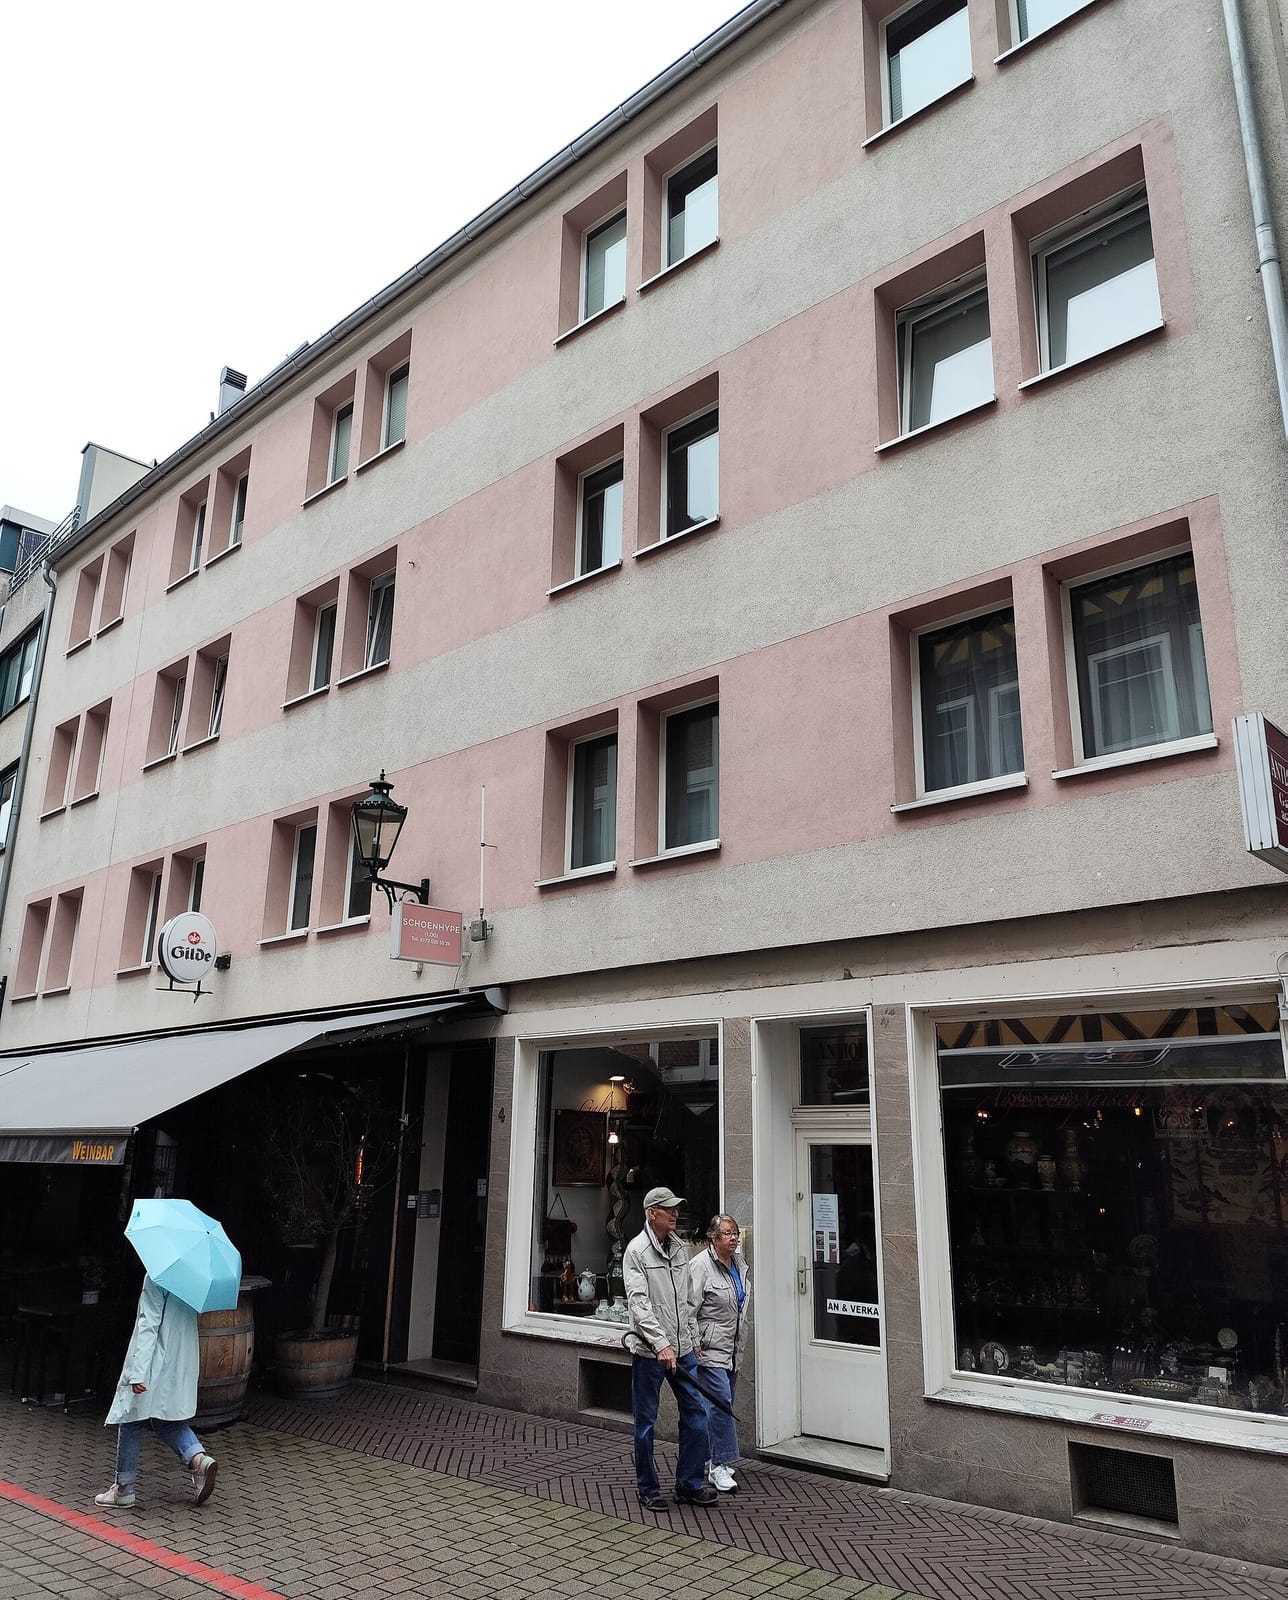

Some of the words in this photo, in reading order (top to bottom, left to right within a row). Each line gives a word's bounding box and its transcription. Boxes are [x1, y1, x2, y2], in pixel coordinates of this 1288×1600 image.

[402, 917, 461, 934] SCHOENHYPE
[171, 946, 212, 963] Gilde
[497, 1106, 506, 1124] 4
[72, 1140, 115, 1161] WEINBAR
[827, 1302, 839, 1312] AN
[841, 1303, 848, 1312] &
[849, 1304, 879, 1317] VERKA
